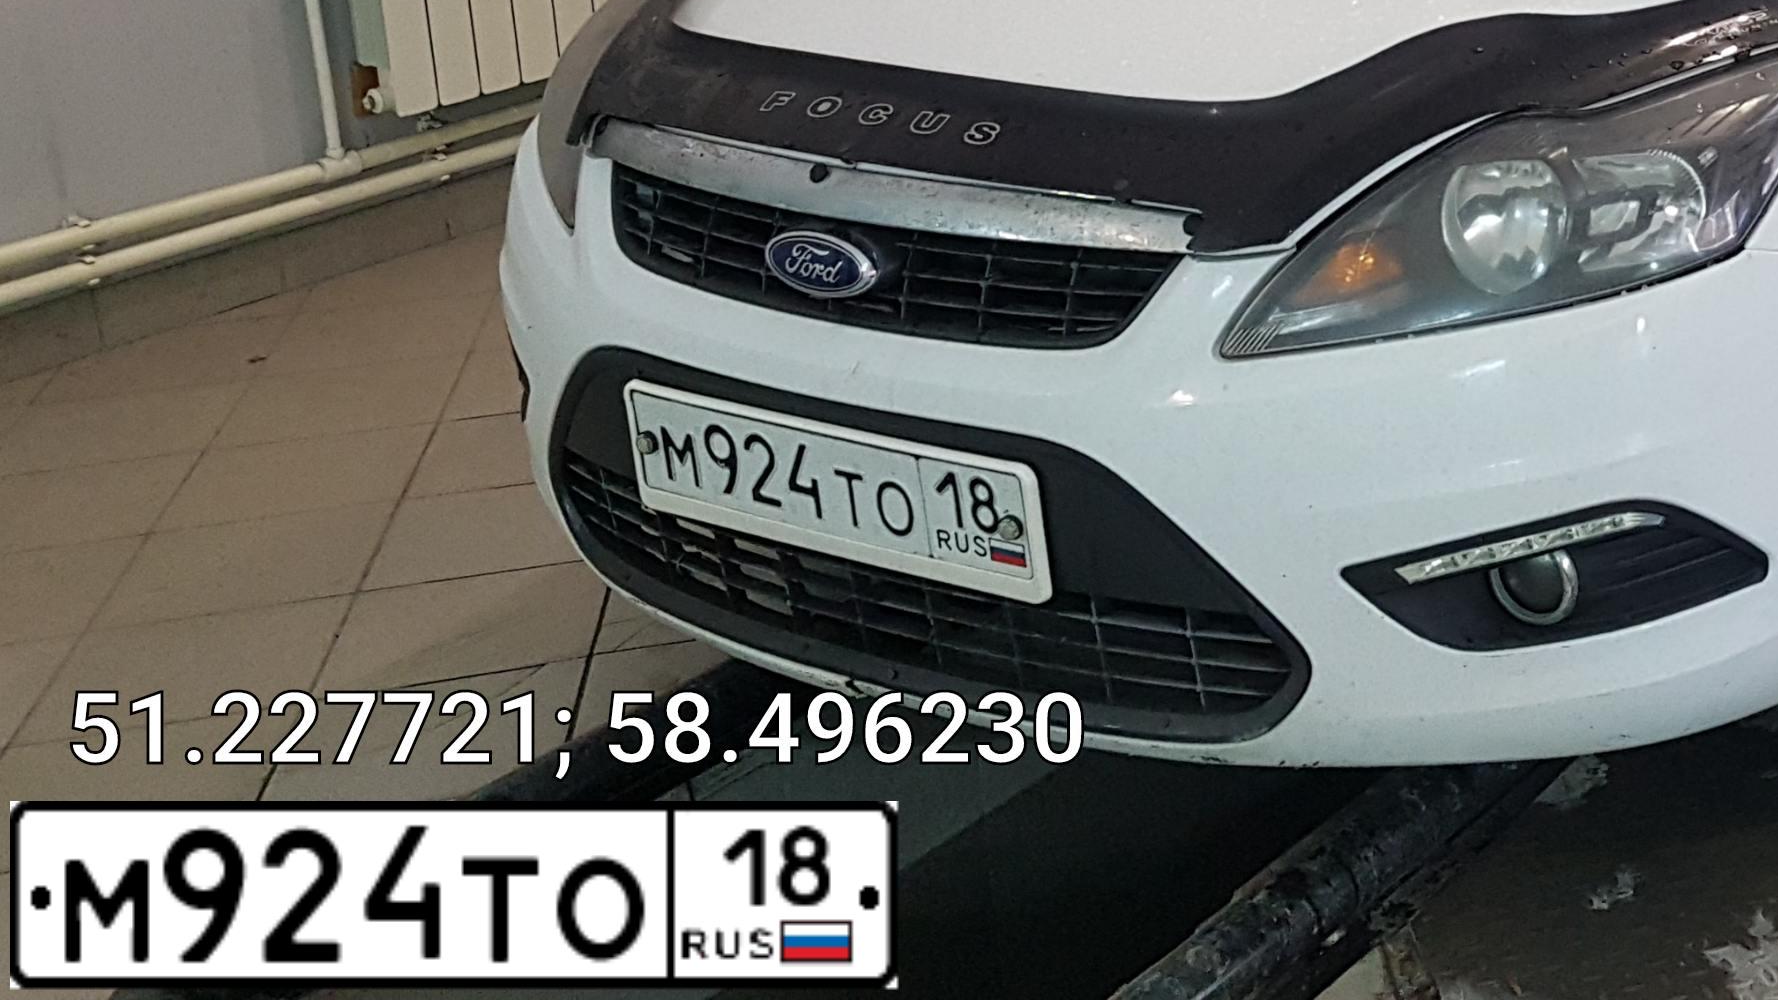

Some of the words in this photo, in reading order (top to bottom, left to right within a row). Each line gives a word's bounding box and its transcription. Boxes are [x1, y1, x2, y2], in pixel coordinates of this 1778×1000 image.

[759, 90, 1001, 146] FOCUS
[784, 243, 844, 284] Ford
[932, 471, 1001, 535] 18
[936, 529, 989, 558] RUS
